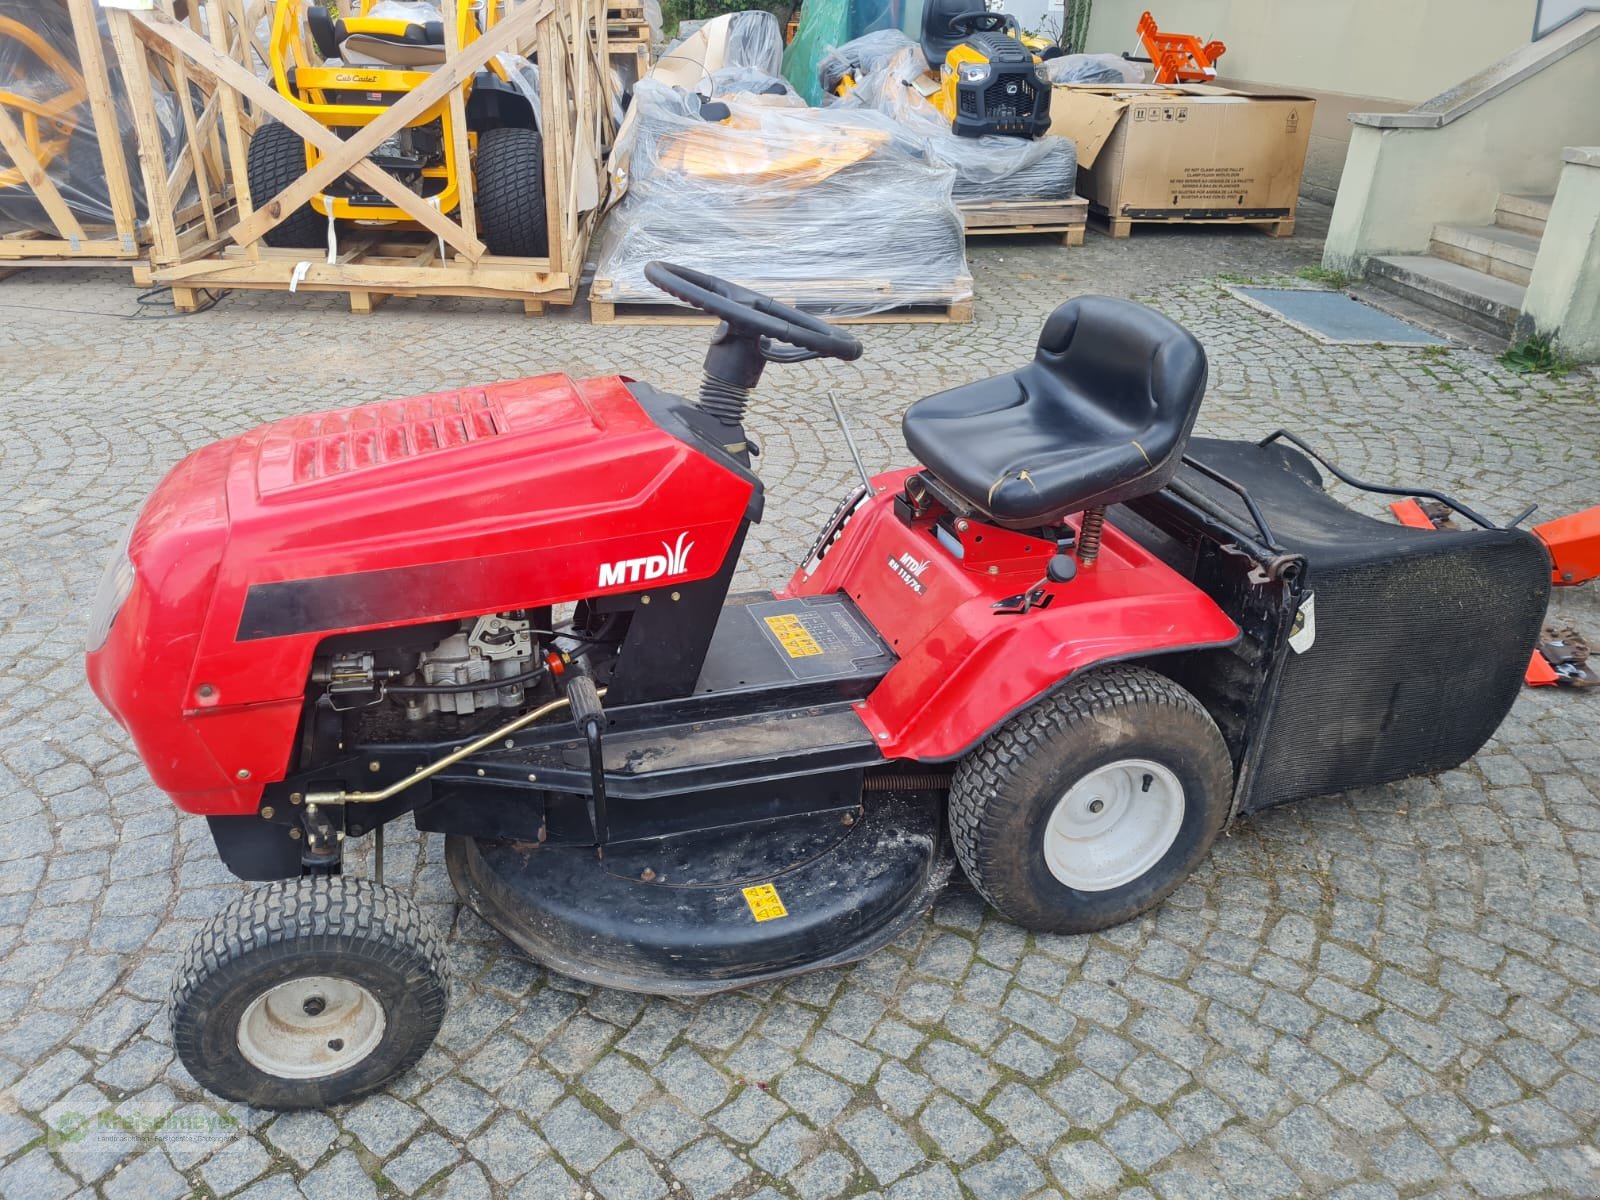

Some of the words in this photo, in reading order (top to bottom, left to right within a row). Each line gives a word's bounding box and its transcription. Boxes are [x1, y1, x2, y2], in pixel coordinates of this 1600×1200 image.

[336, 74, 351, 82] Cub
[353, 74, 378, 83] Cadet
[598, 555, 667, 587] MTD
[900, 552, 920, 572] MTD
